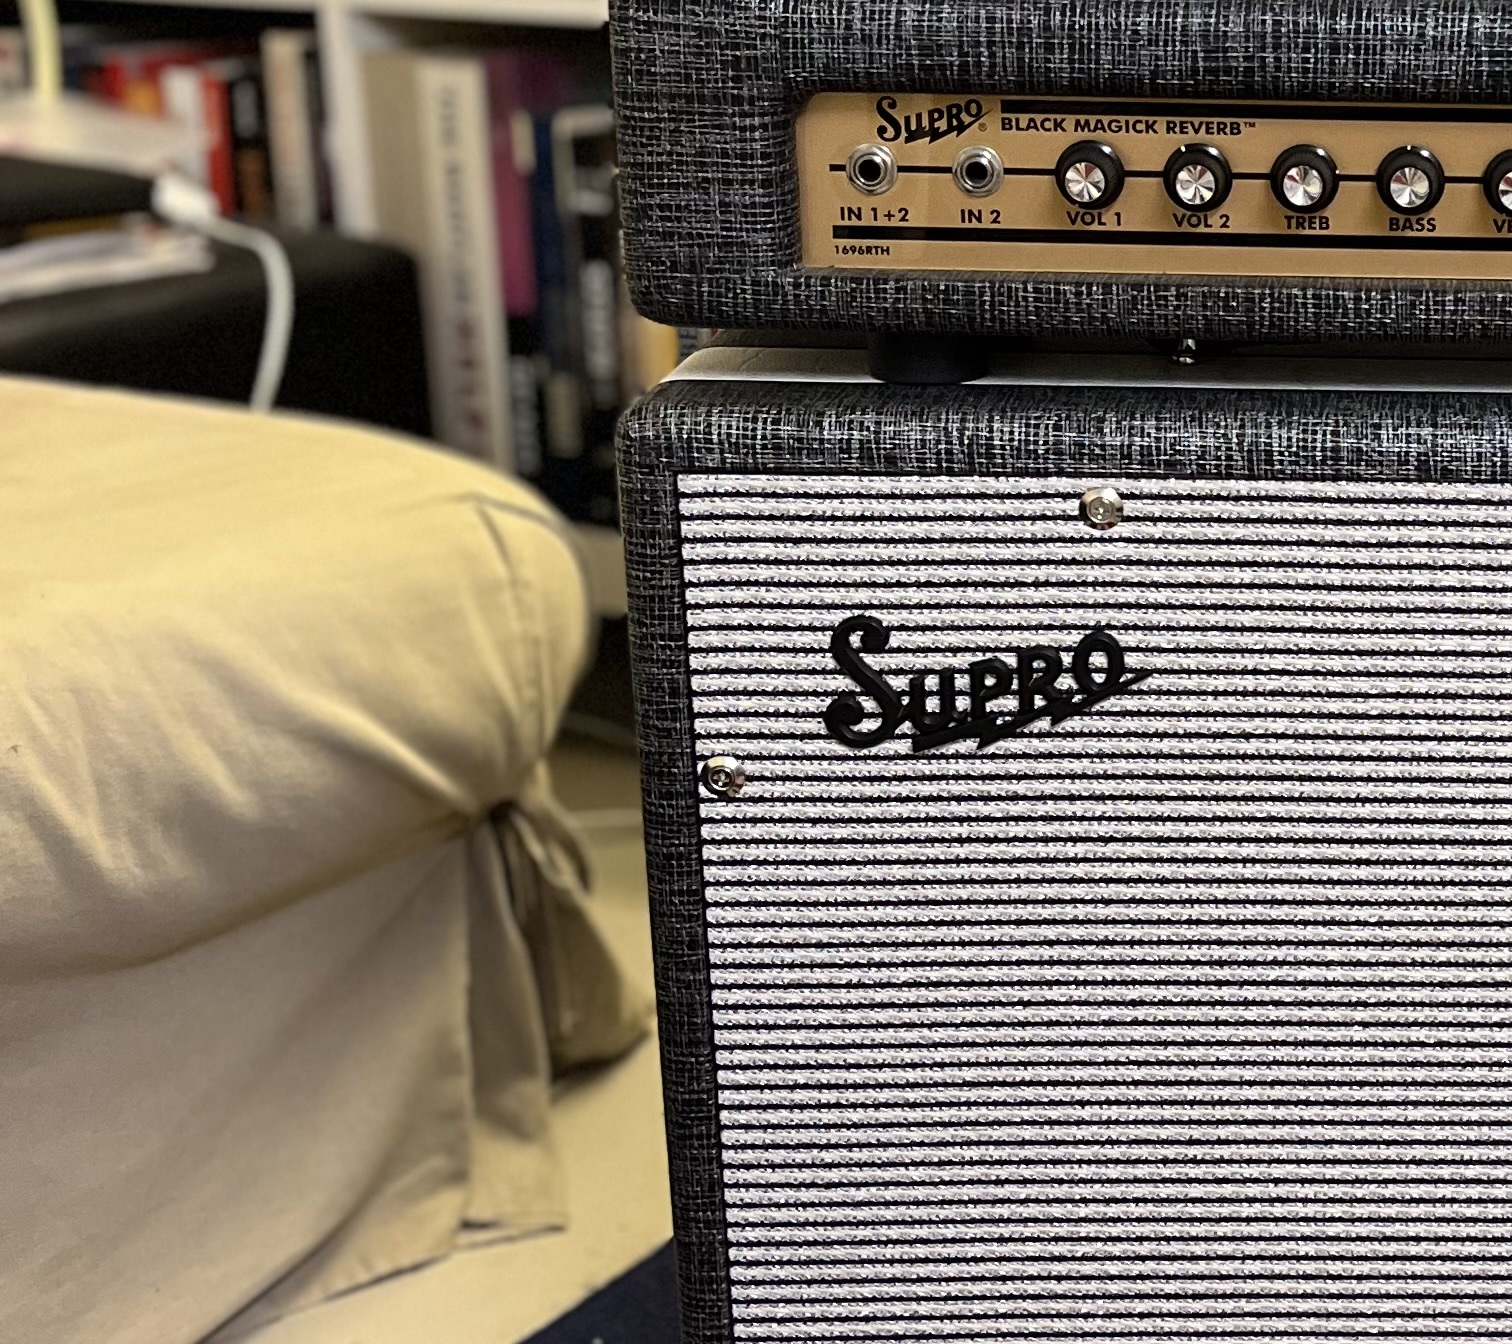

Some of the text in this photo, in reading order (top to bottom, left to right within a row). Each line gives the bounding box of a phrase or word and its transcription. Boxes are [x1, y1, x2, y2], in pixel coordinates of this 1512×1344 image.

[1000, 117, 1067, 133] BLACK
[1074, 118, 1159, 134] MAGICK
[839, 206, 910, 223] IN 1+2
[960, 208, 1002, 225] IN 2
[1065, 210, 1122, 226] VOL 1
[1172, 212, 1231, 229] VOL 2
[1284, 215, 1331, 231] TREB
[1388, 217, 1438, 233] BASS
[833, 244, 891, 256] 1696RTH
